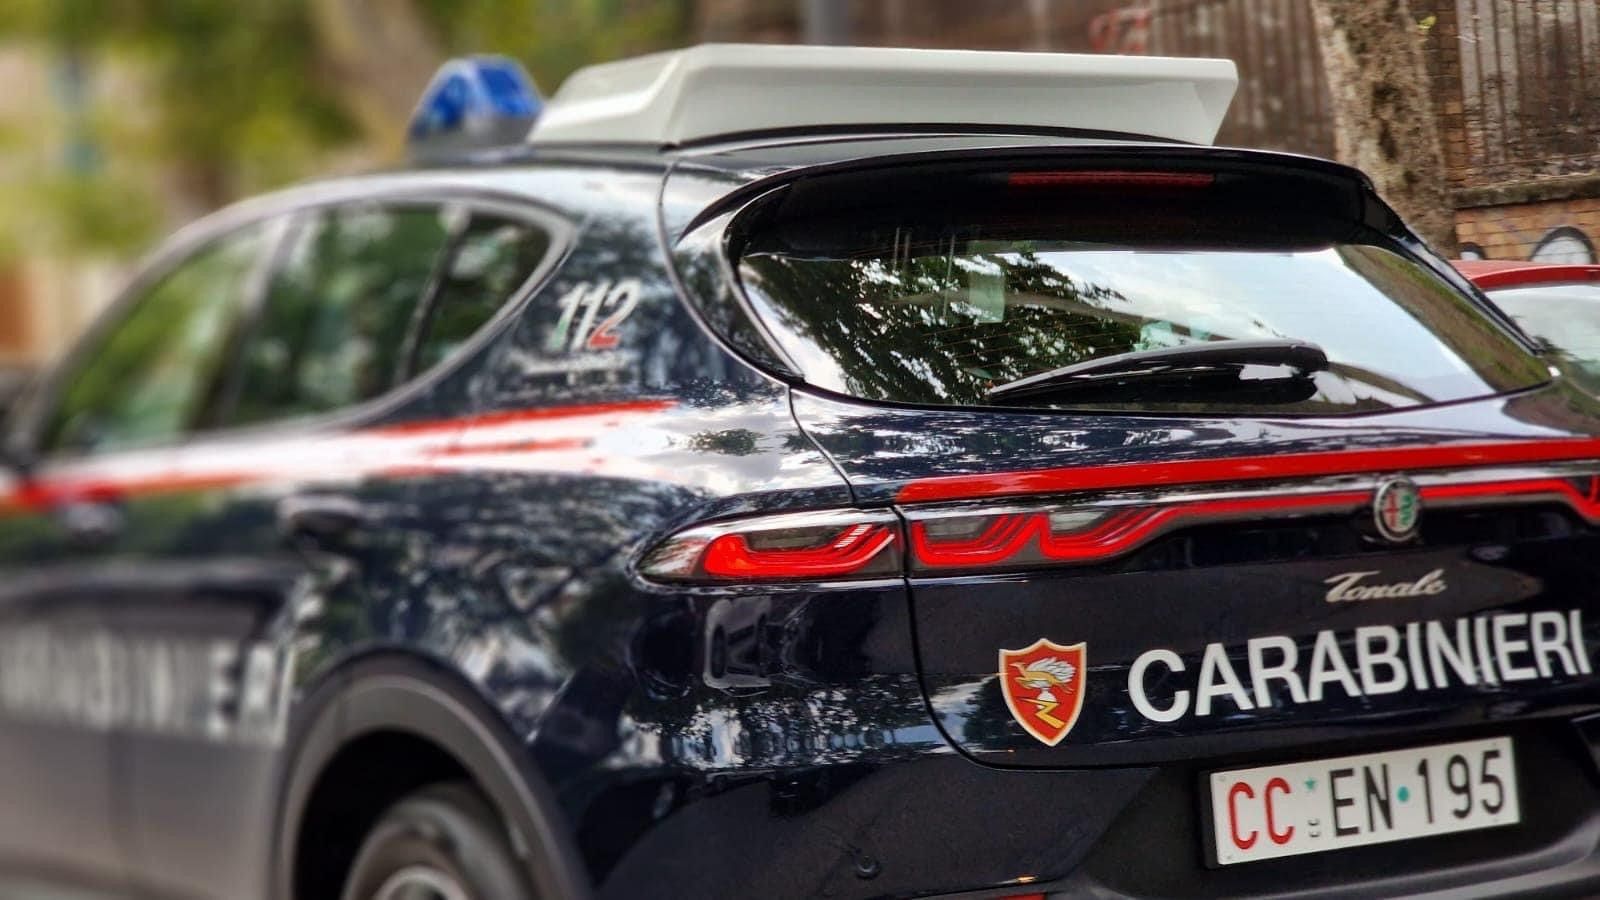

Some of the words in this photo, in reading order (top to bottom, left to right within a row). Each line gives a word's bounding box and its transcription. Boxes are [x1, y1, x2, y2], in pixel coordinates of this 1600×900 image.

[551, 278, 641, 351] 112
[1323, 568, 1448, 603] Tonale
[1127, 609, 1592, 723] CARABINIERI
[1227, 776, 1295, 850] CC
[1328, 763, 1393, 838] EN
[1417, 749, 1505, 824] 195
